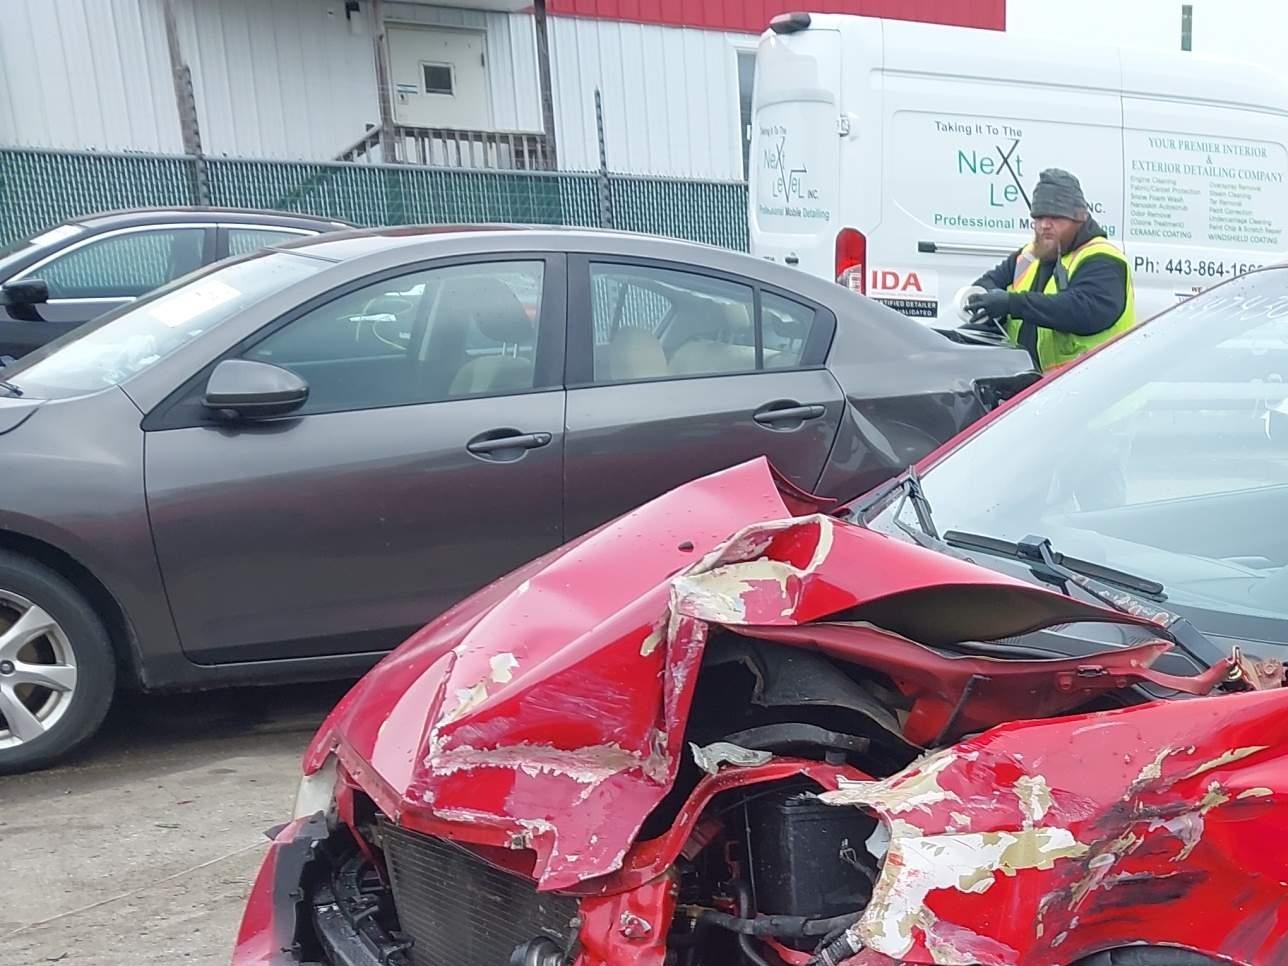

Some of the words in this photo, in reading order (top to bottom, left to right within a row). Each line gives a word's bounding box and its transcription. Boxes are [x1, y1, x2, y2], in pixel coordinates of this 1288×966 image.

[935, 121, 972, 135] Taking
[976, 124, 983, 134] It
[987, 125, 998, 135] To
[1004, 126, 1022, 137] The
[1148, 137, 1177, 149] YOUR
[1178, 139, 1220, 153] PREMIER
[1223, 144, 1267, 158] INTERIOR
[958, 138, 1023, 177] NeXt
[1206, 154, 1213, 165] &
[1132, 160, 1180, 173] EXTERIOR
[1183, 164, 1236, 178] DETAILING
[1238, 168, 1282, 183] COMPANY
[1086, 202, 1106, 214] NC.
[934, 214, 1015, 230] Professional
[1130, 228, 1161, 238] CERAMIC
[1163, 230, 1192, 240] COATING
[1250, 235, 1278, 244] COATING
[1135, 256, 1159, 273] Ph:
[872, 271, 922, 292] IDA
[906, 301, 936, 309] DETAILER
